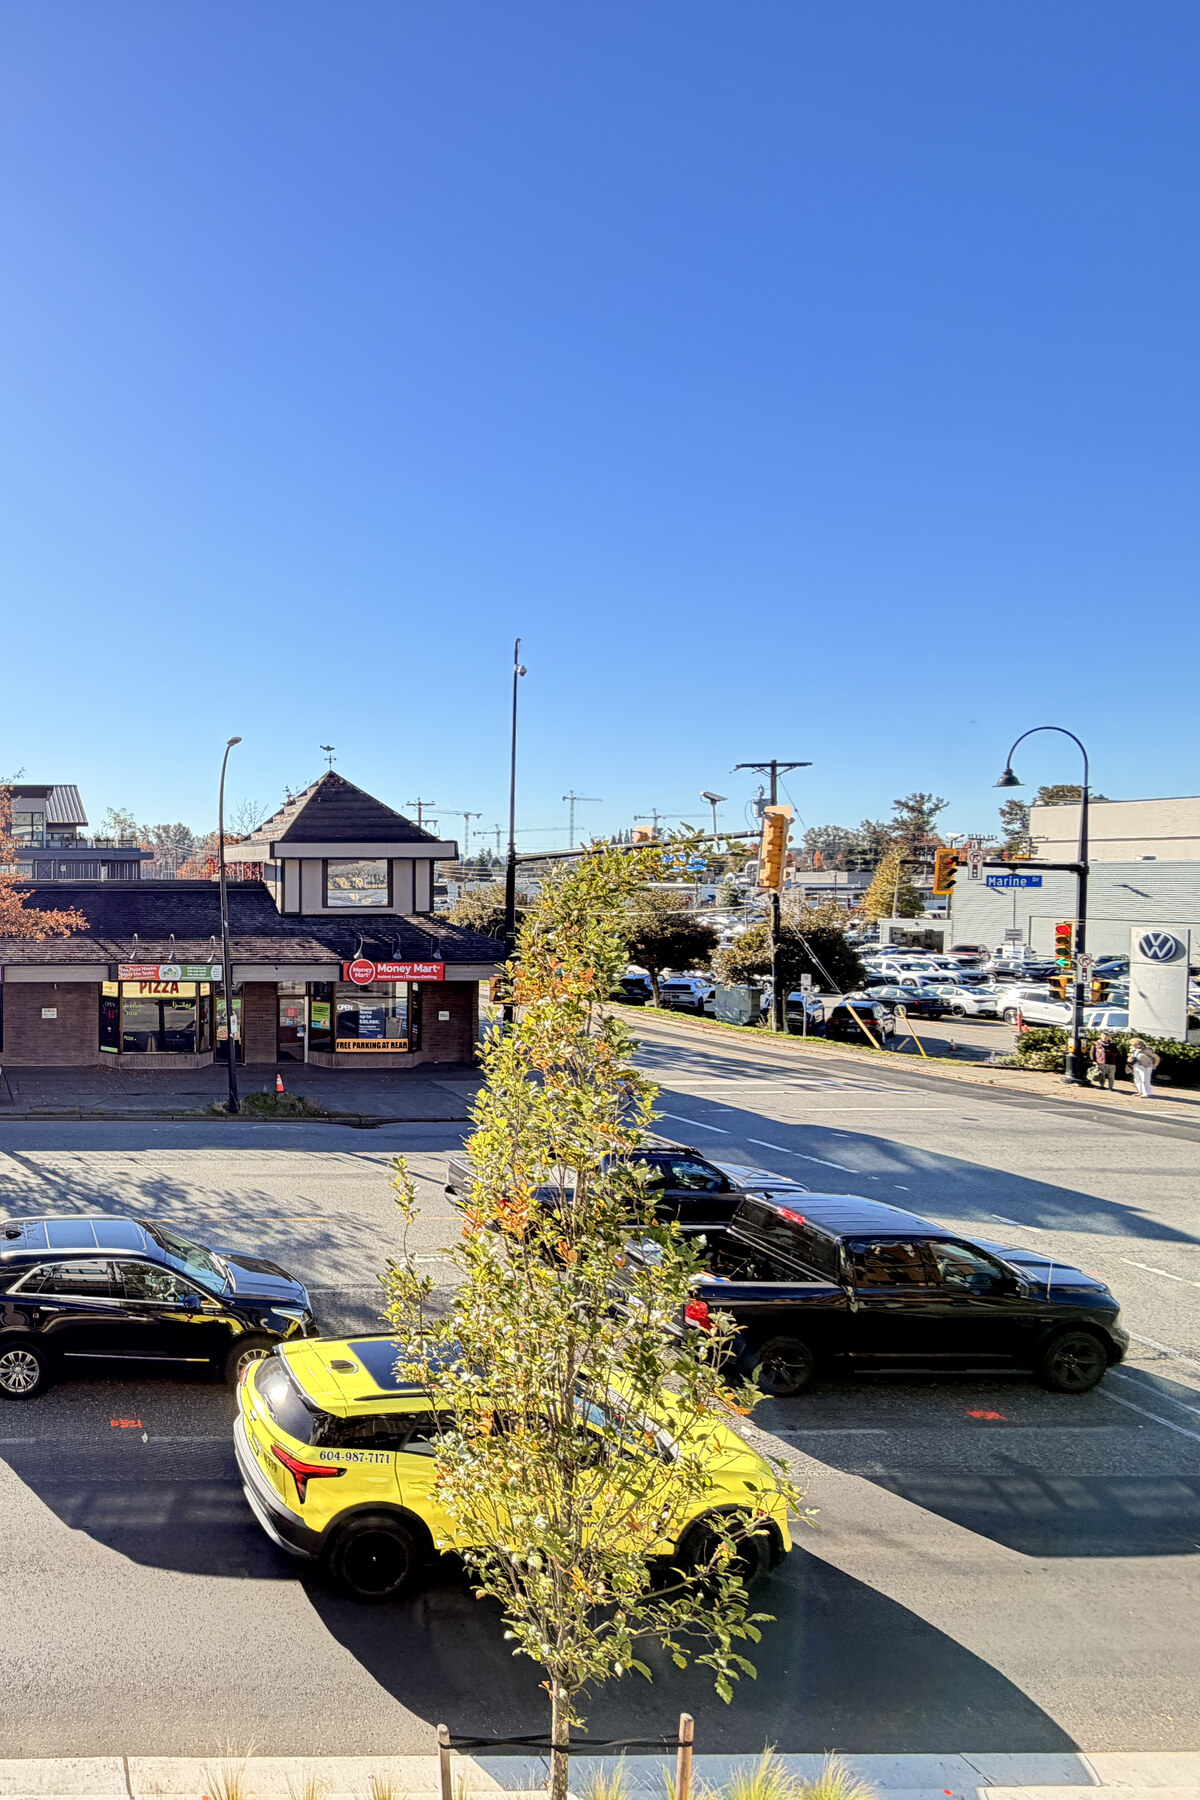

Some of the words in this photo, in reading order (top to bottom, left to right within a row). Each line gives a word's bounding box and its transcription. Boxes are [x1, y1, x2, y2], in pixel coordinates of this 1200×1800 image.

[988, 876, 1027, 886] Marine
[377, 963, 412, 974] Money
[413, 963, 438, 973] Mart
[140, 982, 180, 994] PIZZA
[319, 1451, 390, 1464] 604-987-7171
